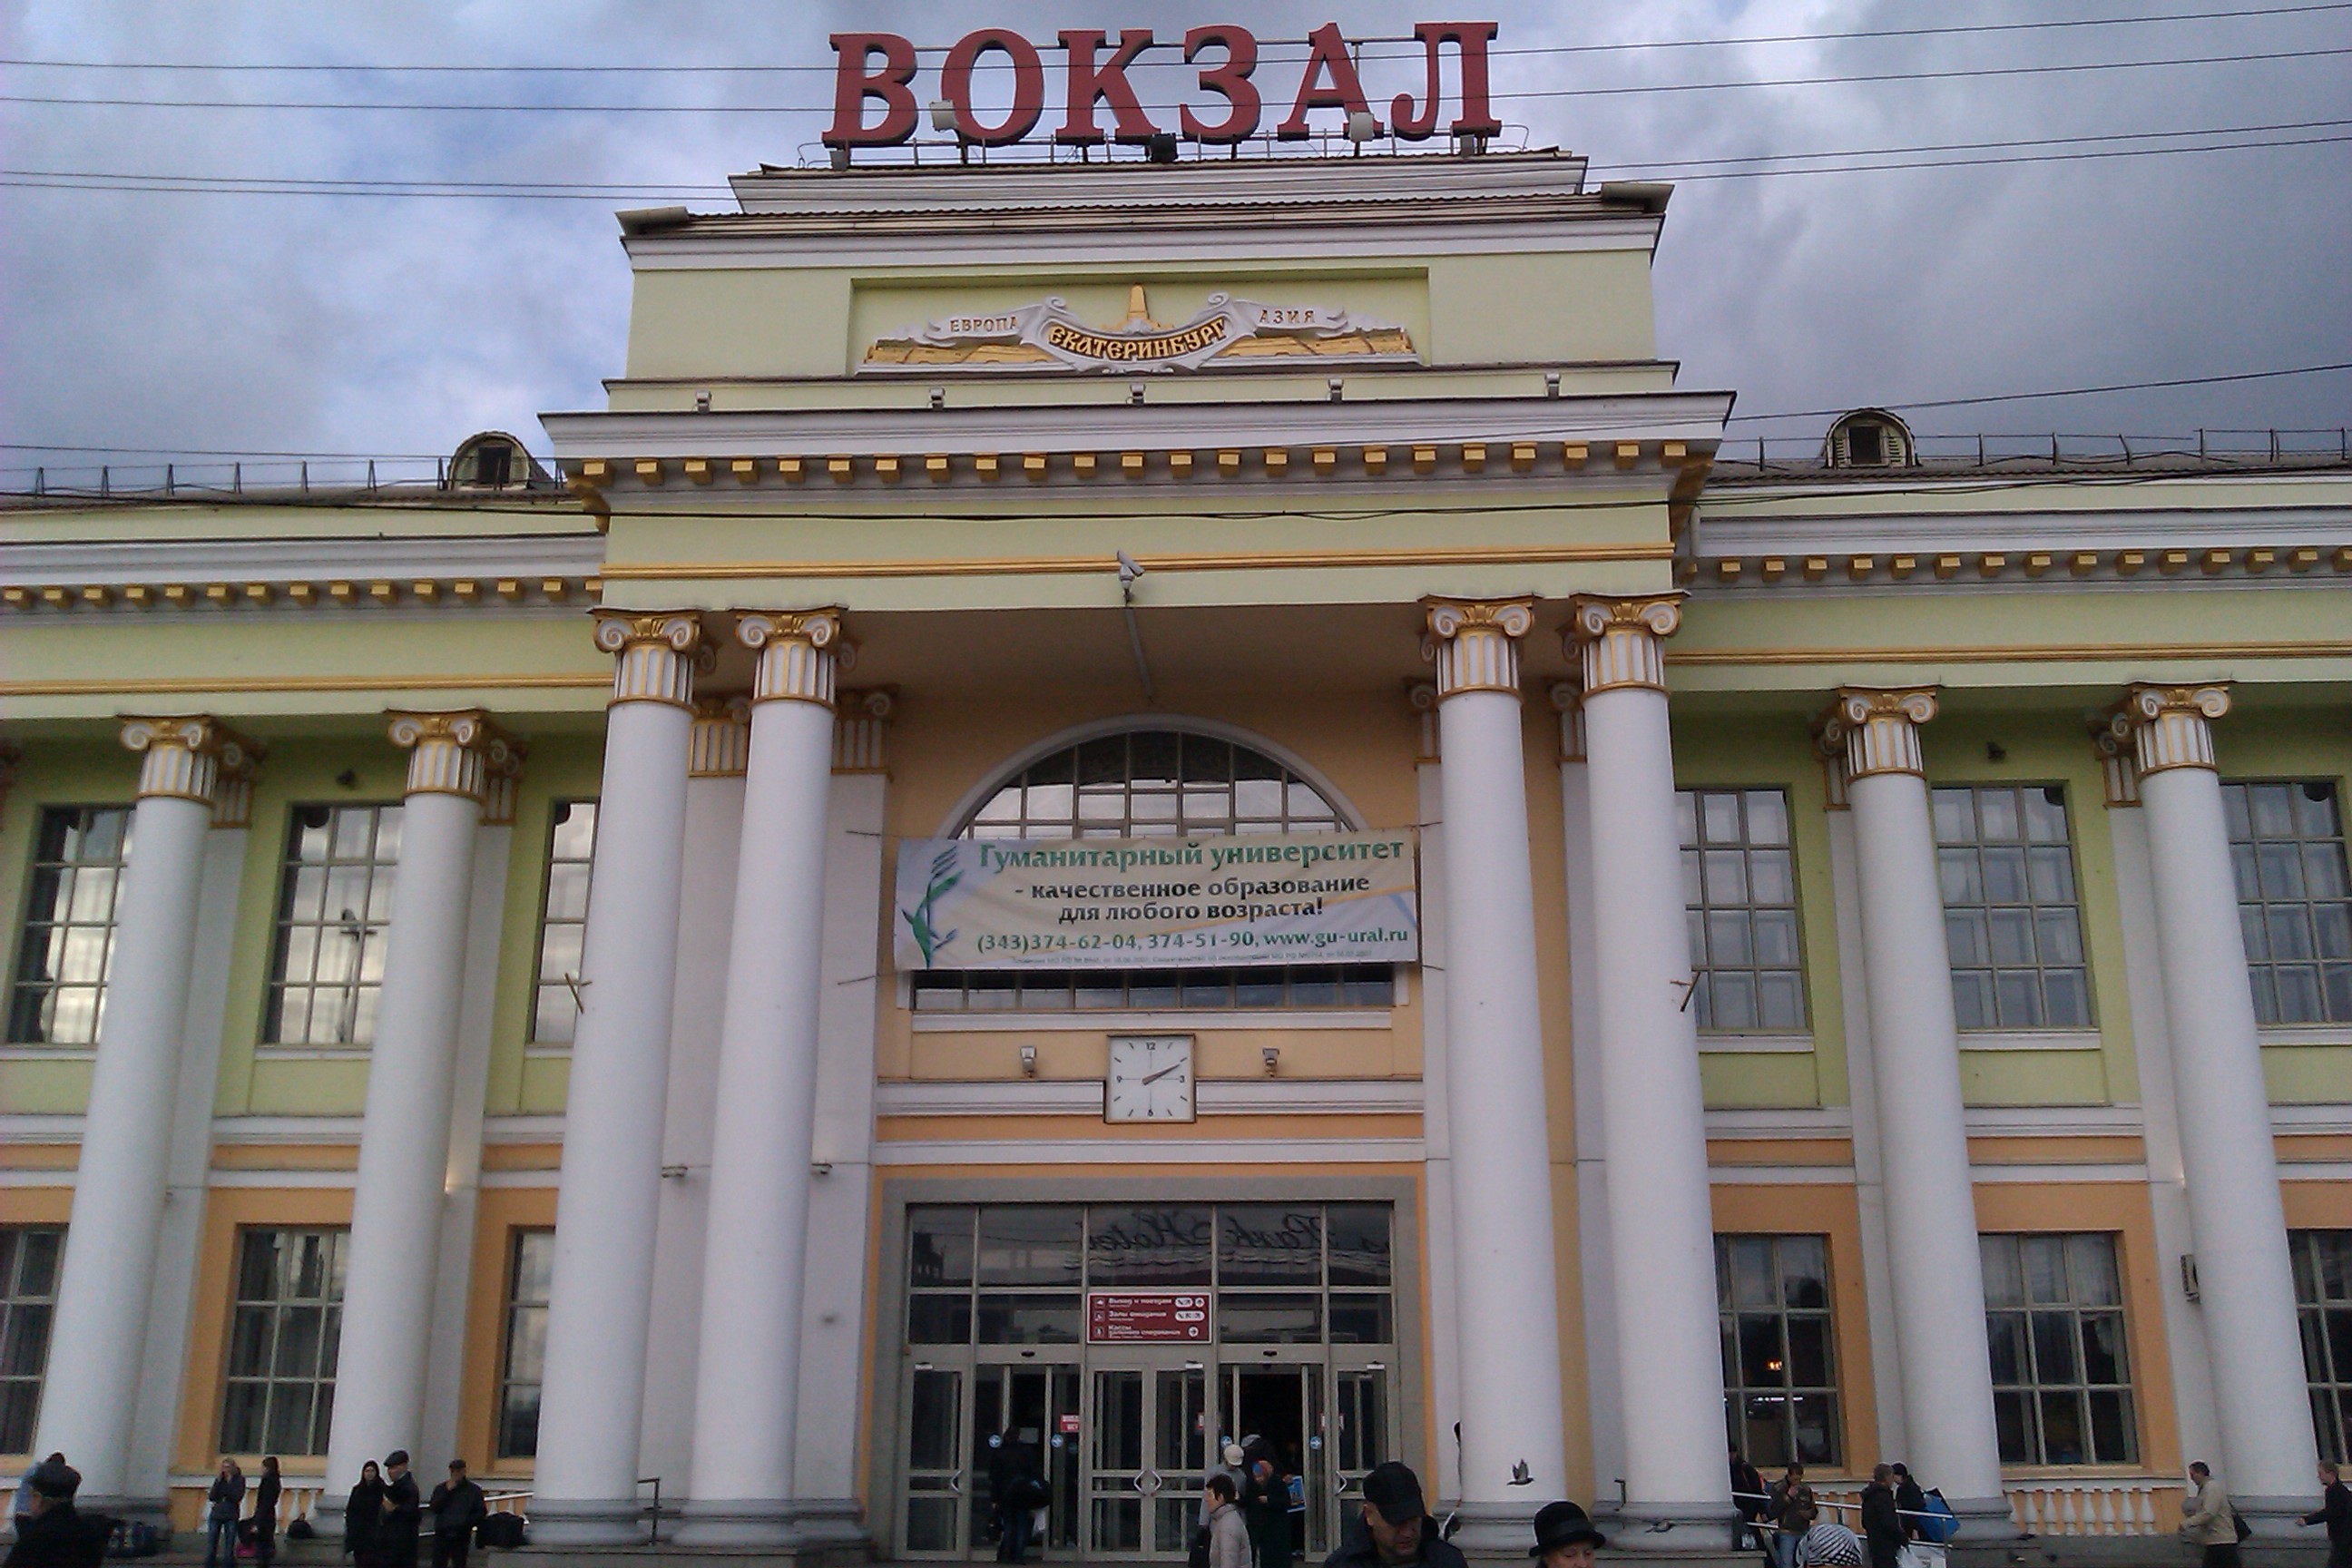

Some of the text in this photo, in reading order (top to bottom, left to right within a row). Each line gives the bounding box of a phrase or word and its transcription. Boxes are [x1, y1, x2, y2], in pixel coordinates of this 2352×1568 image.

[822, 22, 1502, 145] ВОКЗАЛ
[949, 316, 1017, 333] ЕВРОПА
[1259, 309, 1316, 324] АЗИЯ
[1049, 318, 1226, 360] ЕКАТЕРИНБУРГ
[980, 840, 1405, 874] Гуманитарный университет
[1031, 881, 1201, 899] качественное
[1208, 876, 1370, 900] образование
[1058, 897, 1323, 925] для любого возраста!
[977, 927, 1407, 954] (343)374-62-04, 374-51-90, www.gu-ural.ru
[1146, 1042, 1156, 1050] 12
[1147, 1109, 1153, 1117] 6
